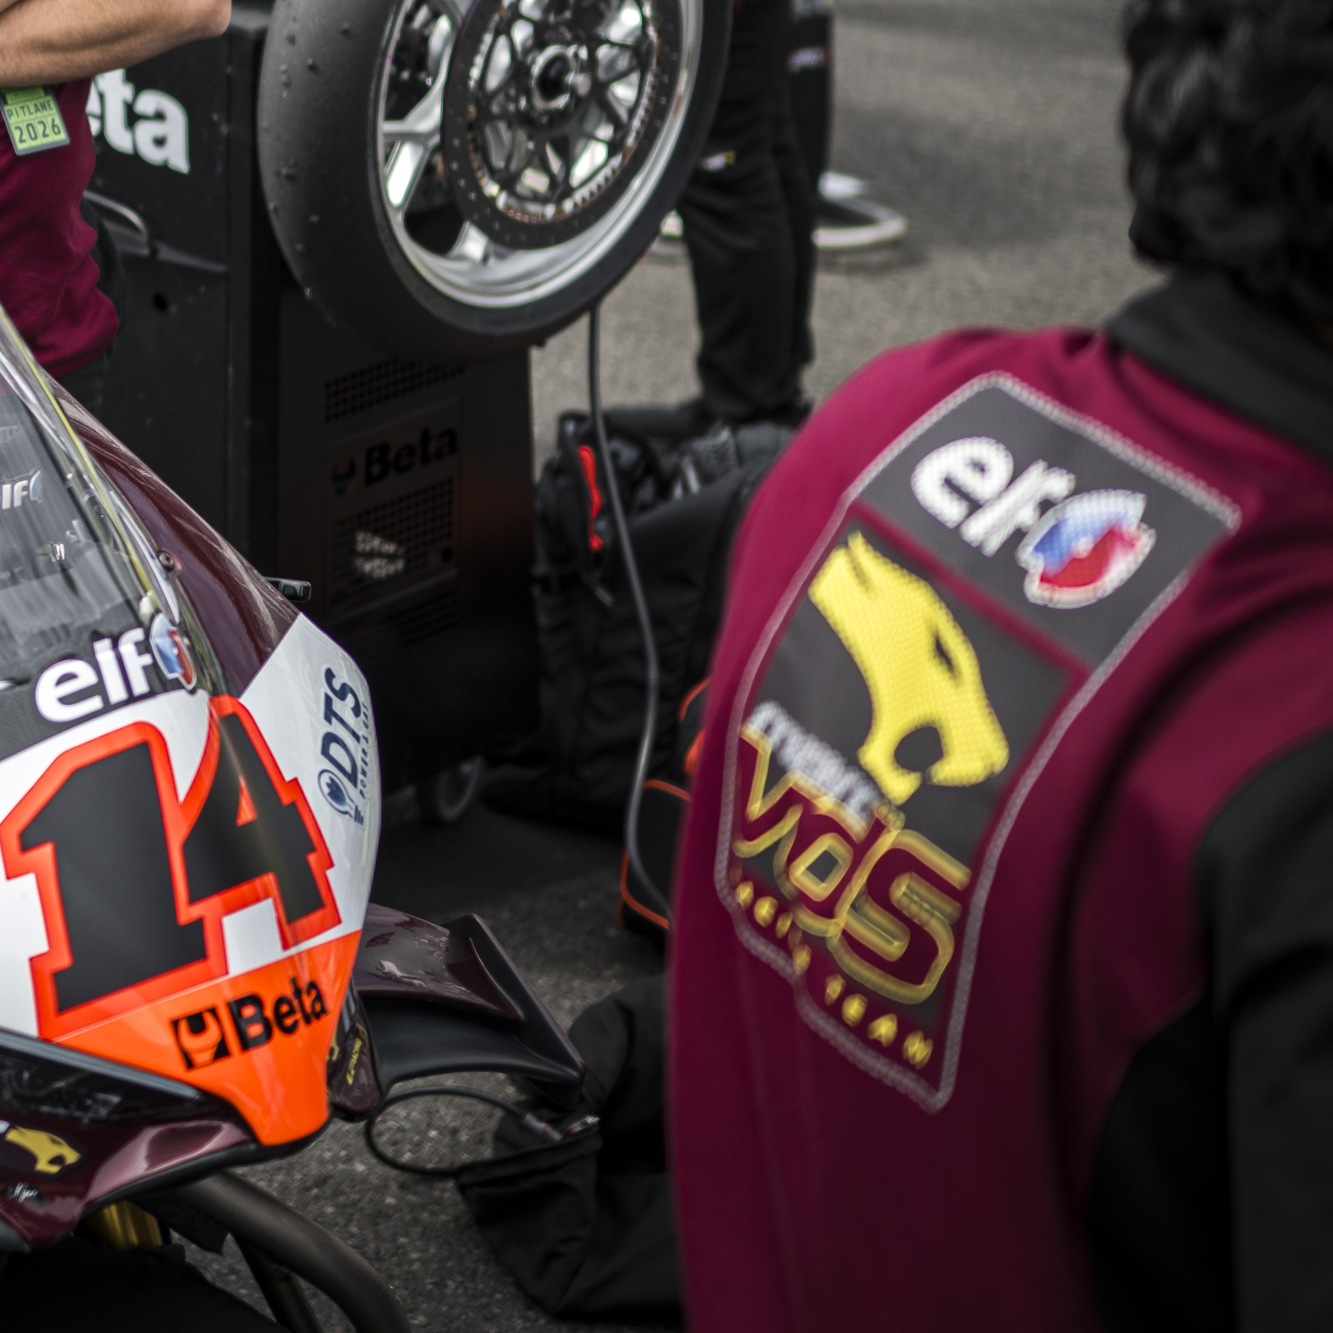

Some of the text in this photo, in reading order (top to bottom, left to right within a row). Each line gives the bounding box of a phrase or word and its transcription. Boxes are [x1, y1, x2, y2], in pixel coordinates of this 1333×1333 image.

[6, 98, 55, 121] PITLANE
[13, 117, 62, 145] 2026
[364, 426, 459, 487] Beta
[34, 627, 153, 723] elf
[320, 666, 363, 790] DTS
[226, 975, 329, 1053] Beta
